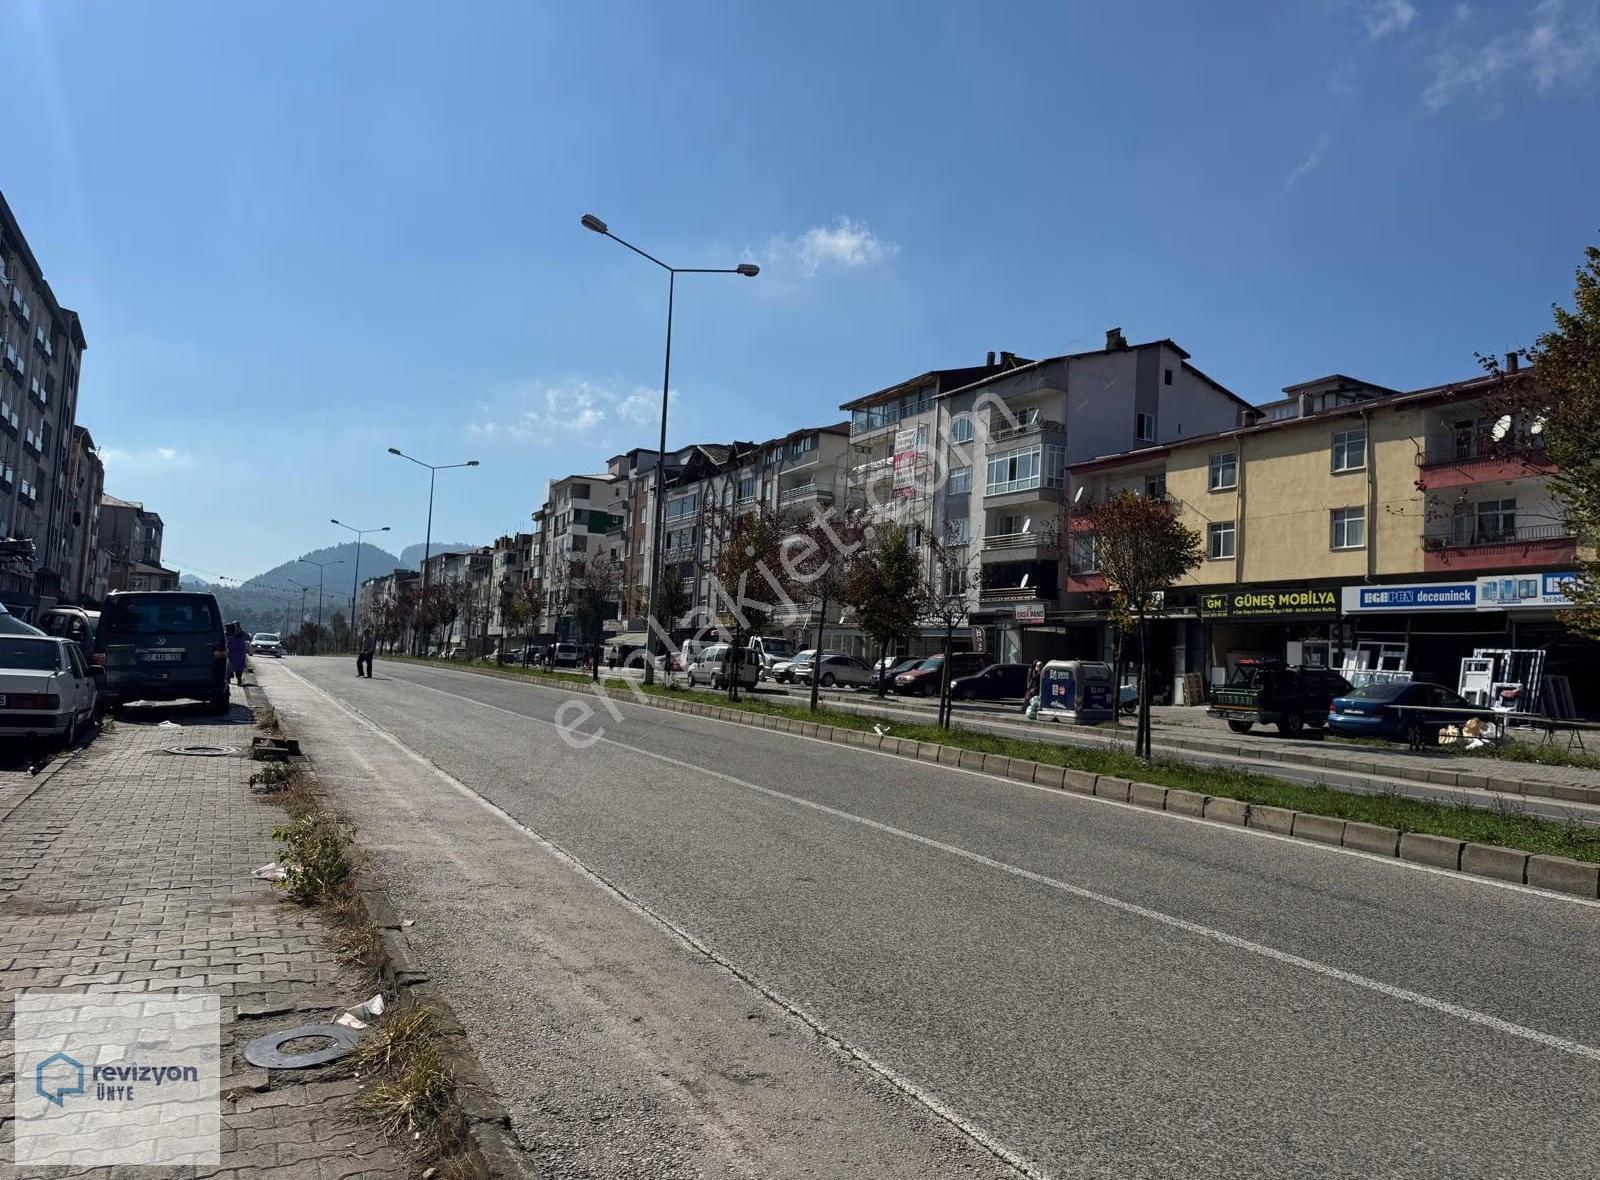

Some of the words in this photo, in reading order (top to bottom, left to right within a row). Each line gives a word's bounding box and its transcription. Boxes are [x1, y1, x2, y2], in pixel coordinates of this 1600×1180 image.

[1234, 594, 1276, 608] GÜNEŞ
[1279, 590, 1336, 605] MOBİLYA
[1417, 589, 1471, 602] deceuninck
[1207, 599, 1222, 609] GM
